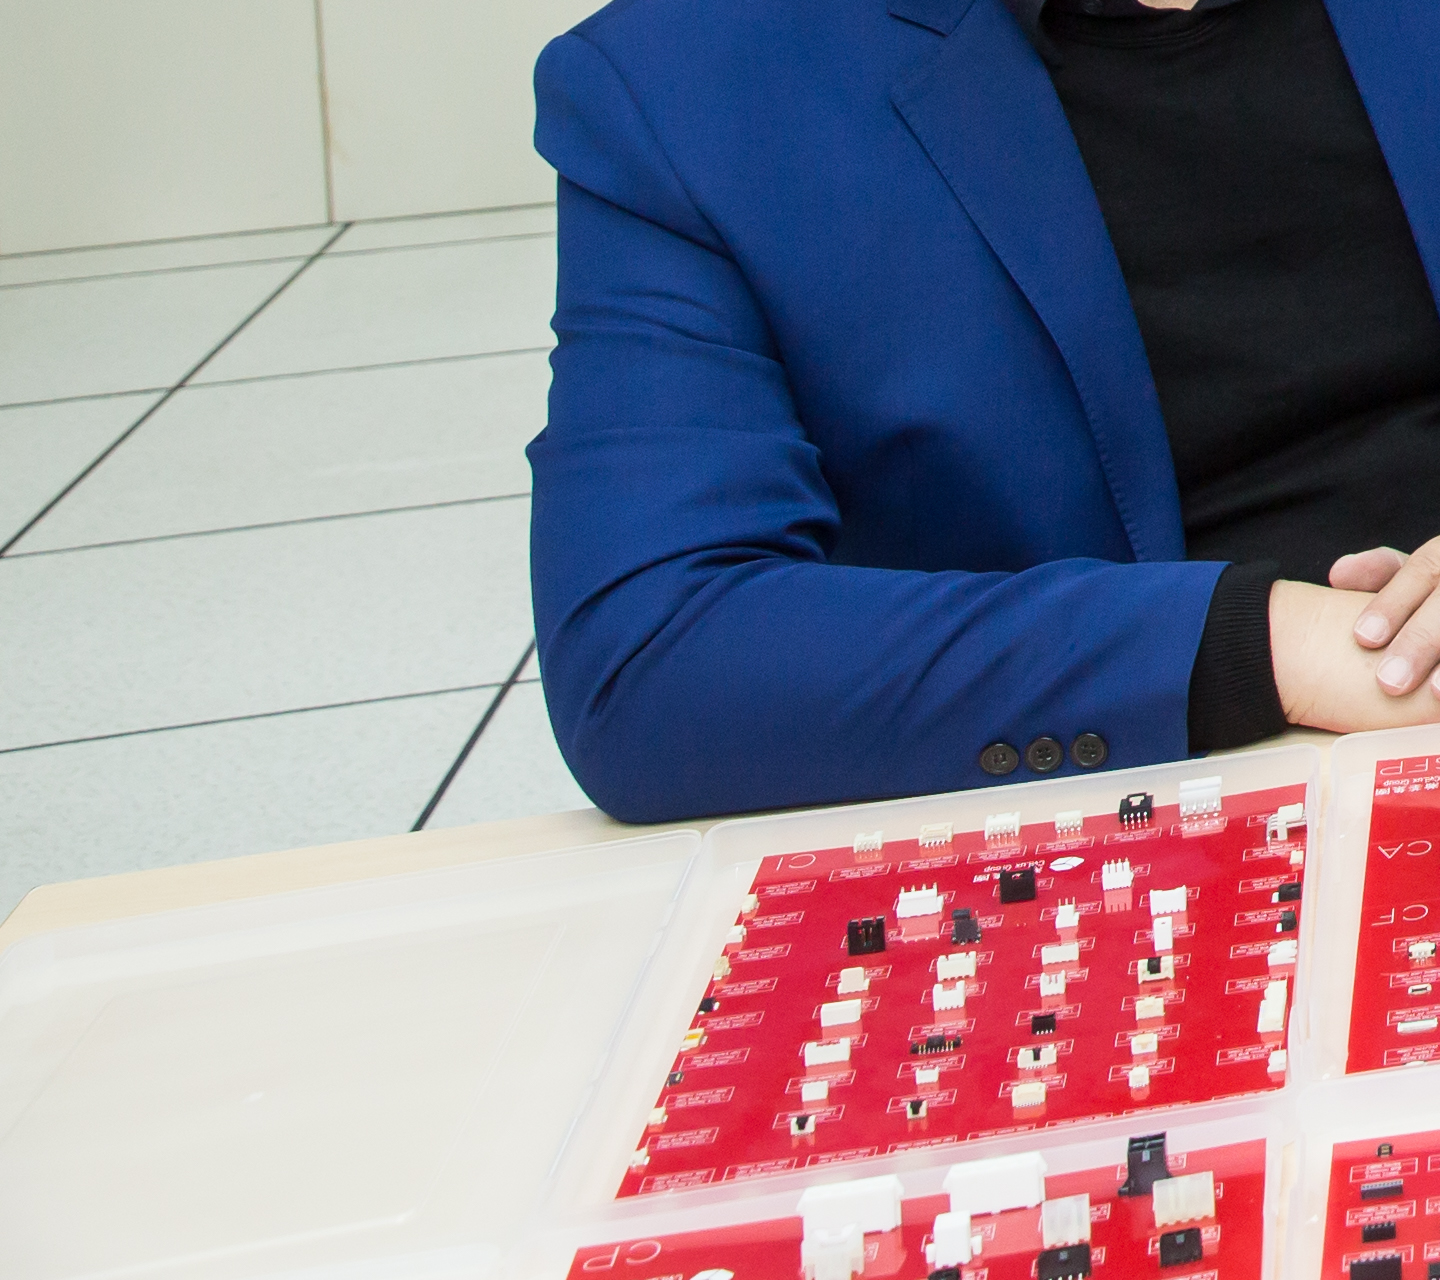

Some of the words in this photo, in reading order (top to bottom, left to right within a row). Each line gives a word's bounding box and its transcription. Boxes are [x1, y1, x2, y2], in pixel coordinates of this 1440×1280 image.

[1378, 840, 1432, 859] CA
[777, 853, 816, 871] CI
[1371, 904, 1429, 927] CF
[582, 1240, 662, 1271] CP
